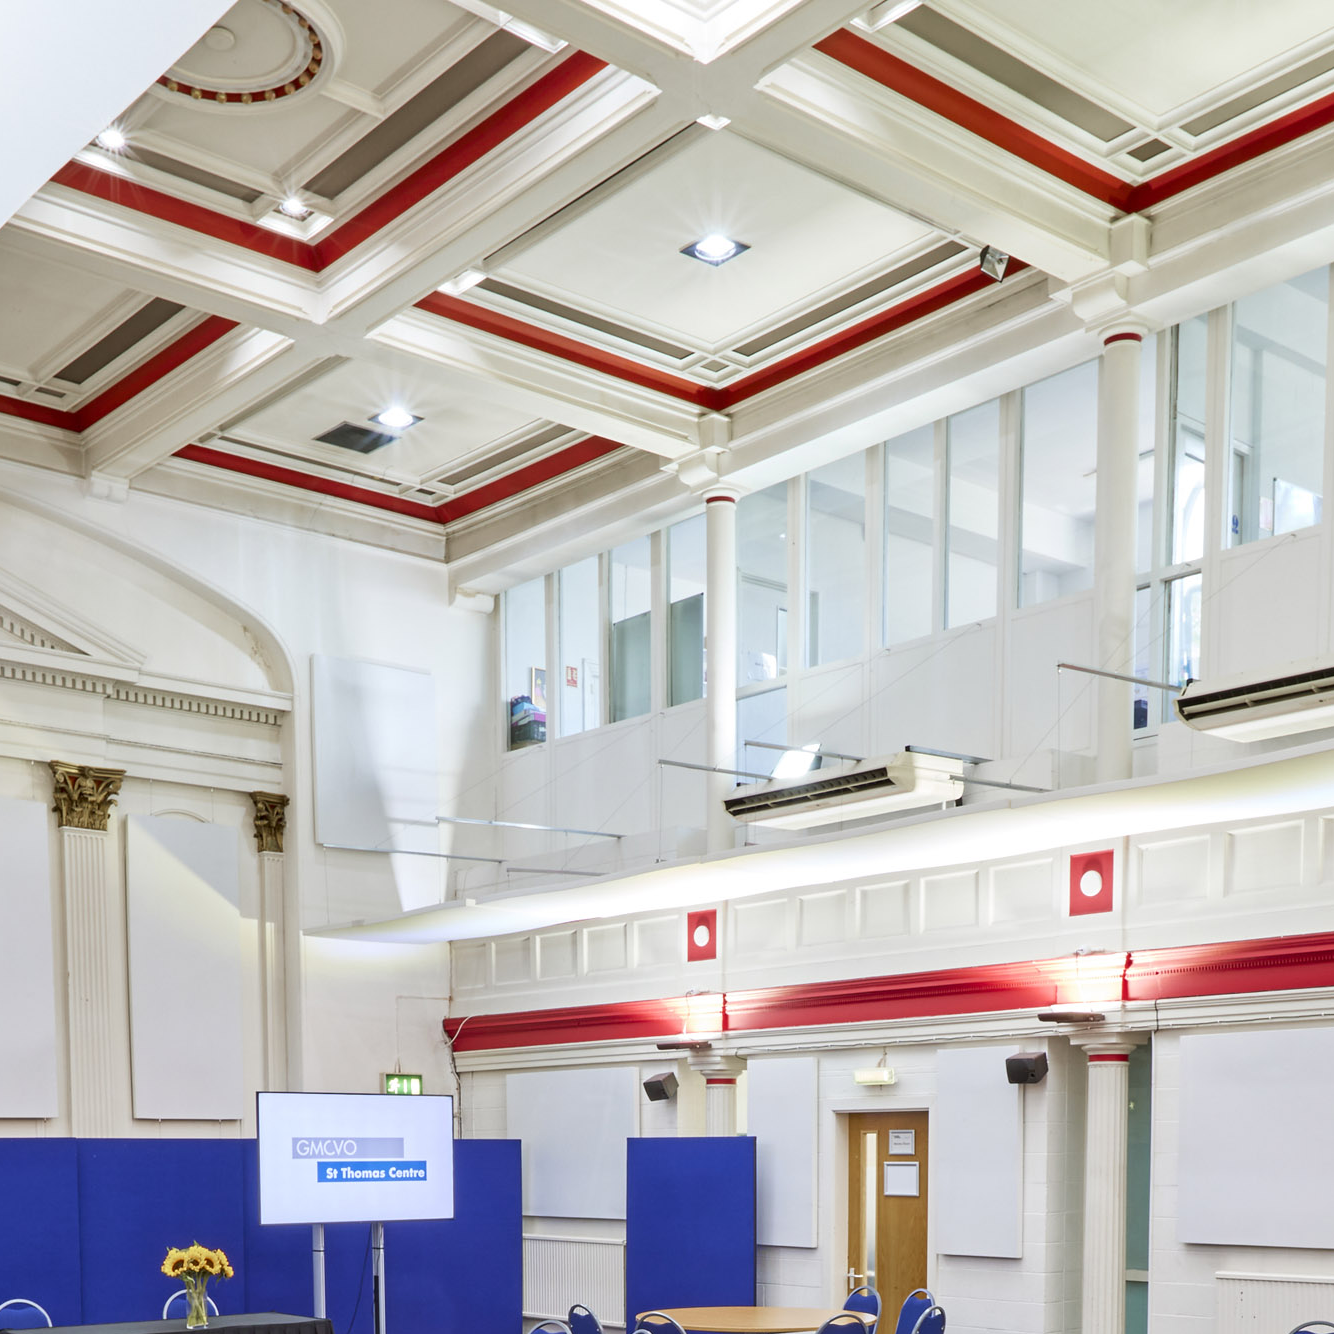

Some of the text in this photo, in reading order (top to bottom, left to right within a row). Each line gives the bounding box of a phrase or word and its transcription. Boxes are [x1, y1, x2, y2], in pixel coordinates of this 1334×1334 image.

[296, 1139, 357, 1156] GMCVO
[326, 1166, 425, 1179] St Thomas Centre
